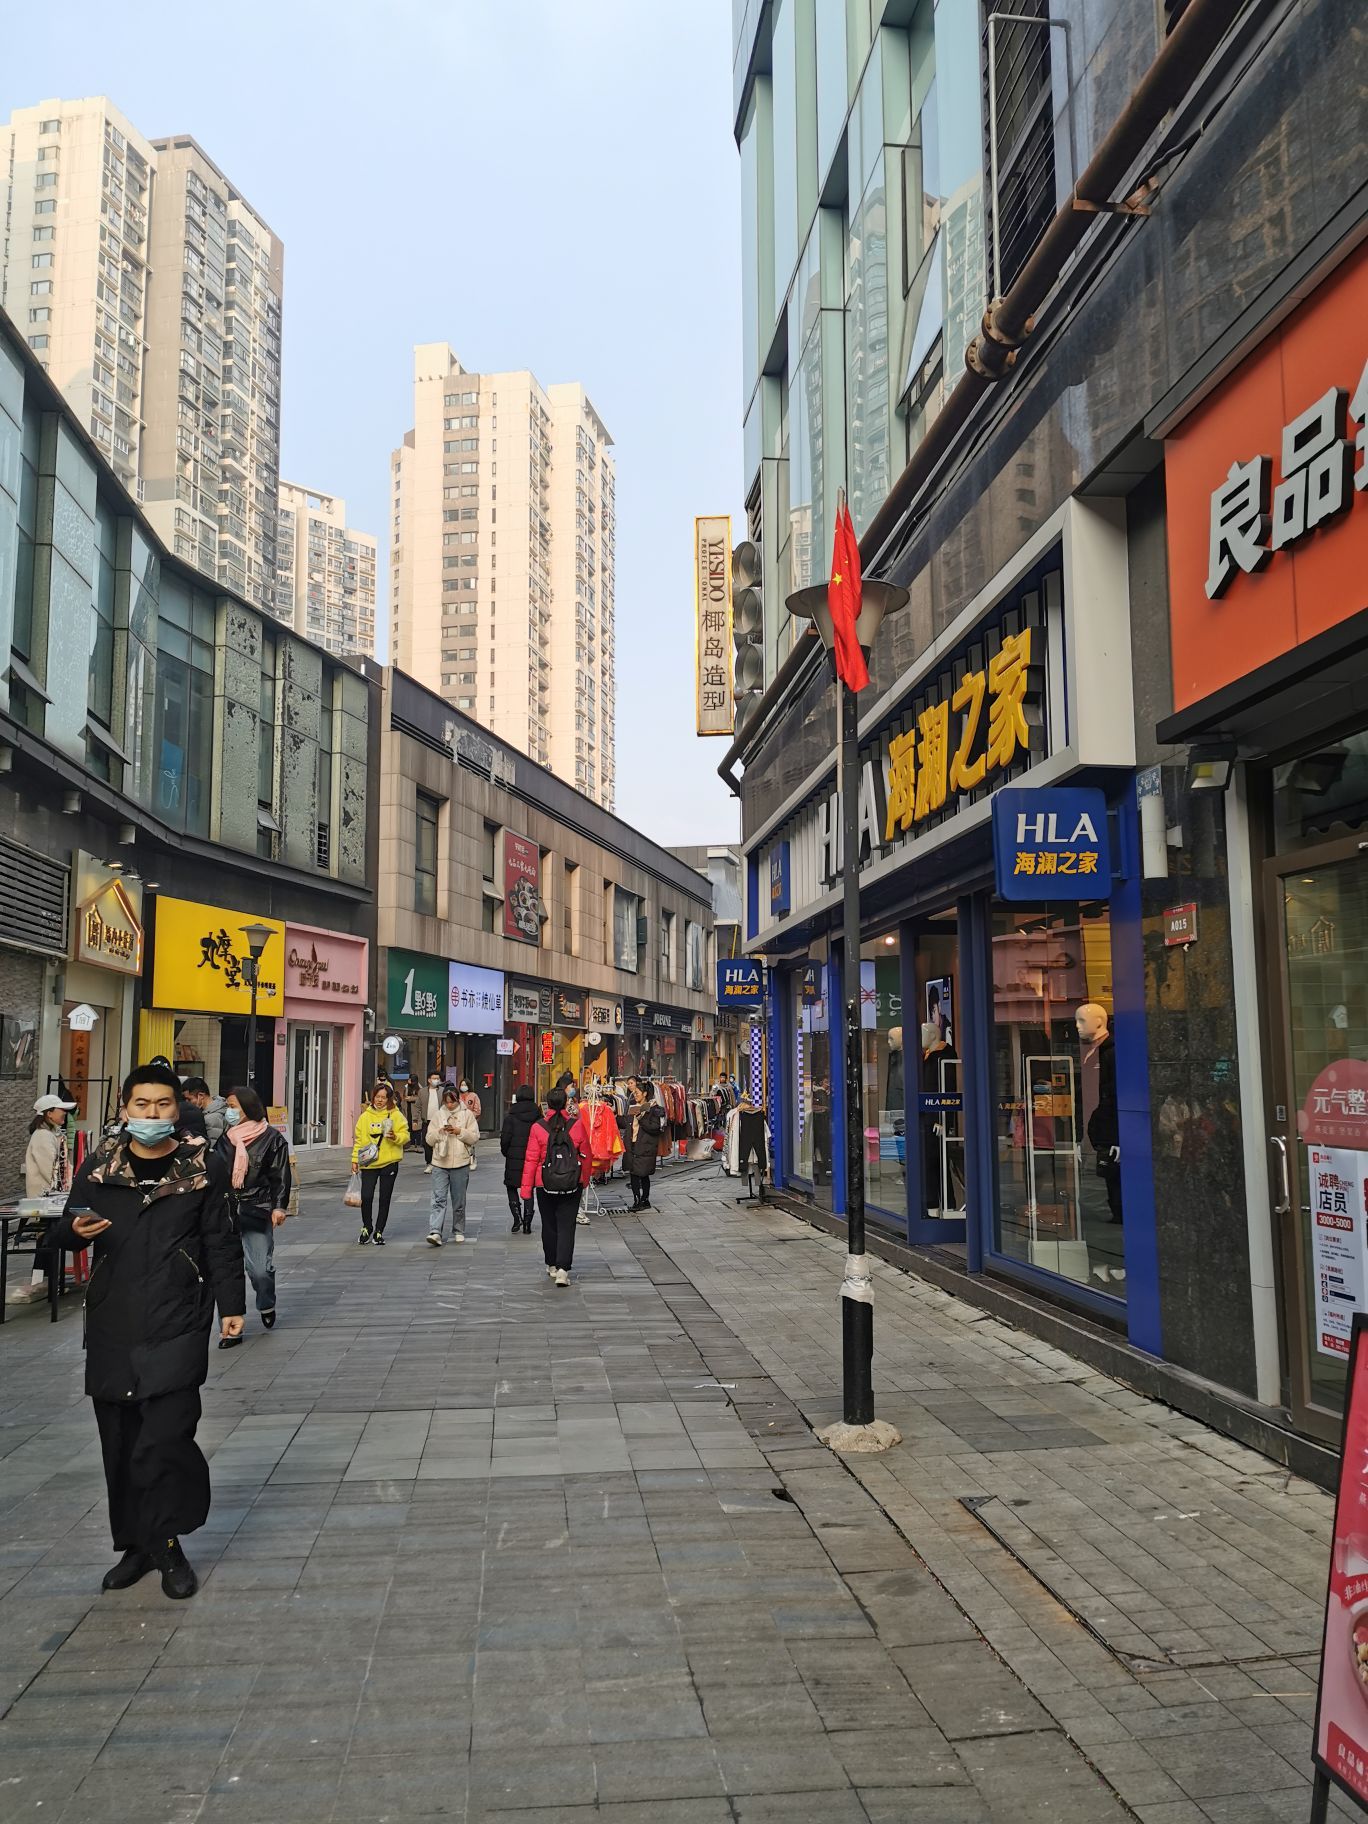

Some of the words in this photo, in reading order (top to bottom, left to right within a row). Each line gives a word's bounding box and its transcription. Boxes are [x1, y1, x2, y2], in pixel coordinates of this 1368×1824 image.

[709, 538, 725, 602] YESIDO
[702, 609, 726, 710] 椰岛造型
[885, 626, 1031, 841] 海澜之家
[1016, 813, 1098, 843] HLA
[1014, 851, 1099, 875] 海澜之家
[1170, 917, 1187, 932] A015
[725, 968, 759, 982] HLA
[724, 985, 758, 995] 海澜之家
[925, 1098, 940, 1106] HLA
[1313, 1088, 1368, 1116] 元气整
[1318, 1172, 1340, 1191] 诚聘
[1319, 1189, 1347, 1213] 店员
[1318, 1214, 1351, 1229] 3000-5000
